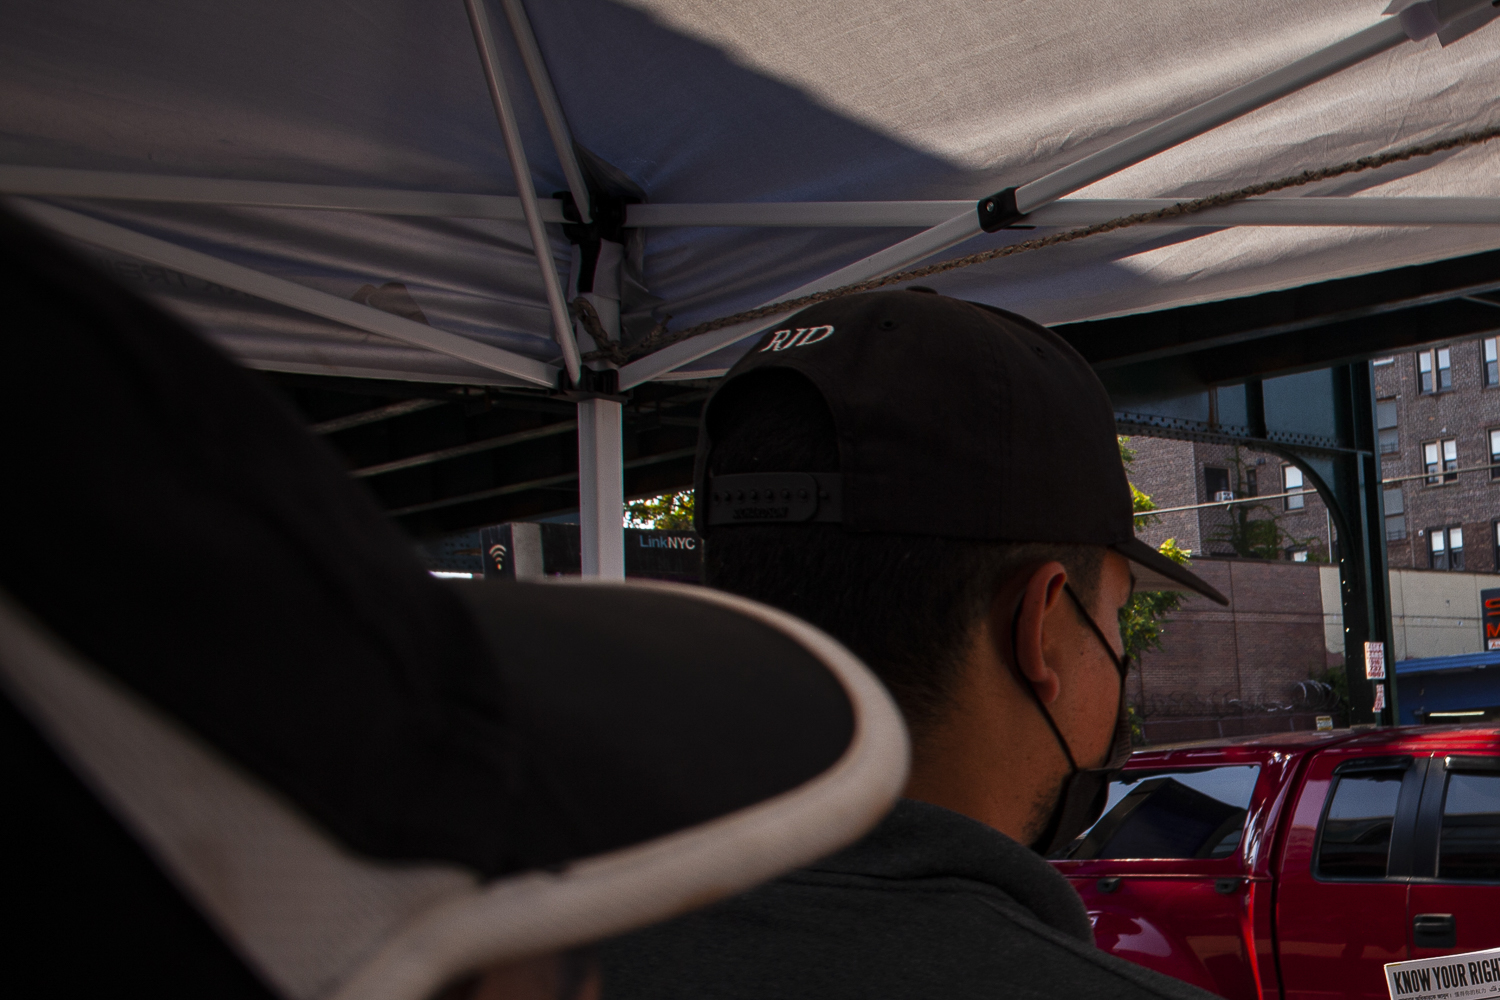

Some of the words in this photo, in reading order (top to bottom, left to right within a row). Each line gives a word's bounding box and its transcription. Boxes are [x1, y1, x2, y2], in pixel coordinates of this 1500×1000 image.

[759, 325, 835, 353] RJD
[639, 534, 696, 550] LinkNYC
[1393, 967, 1431, 995] KNOW
[1432, 963, 1468, 990] YOUR
